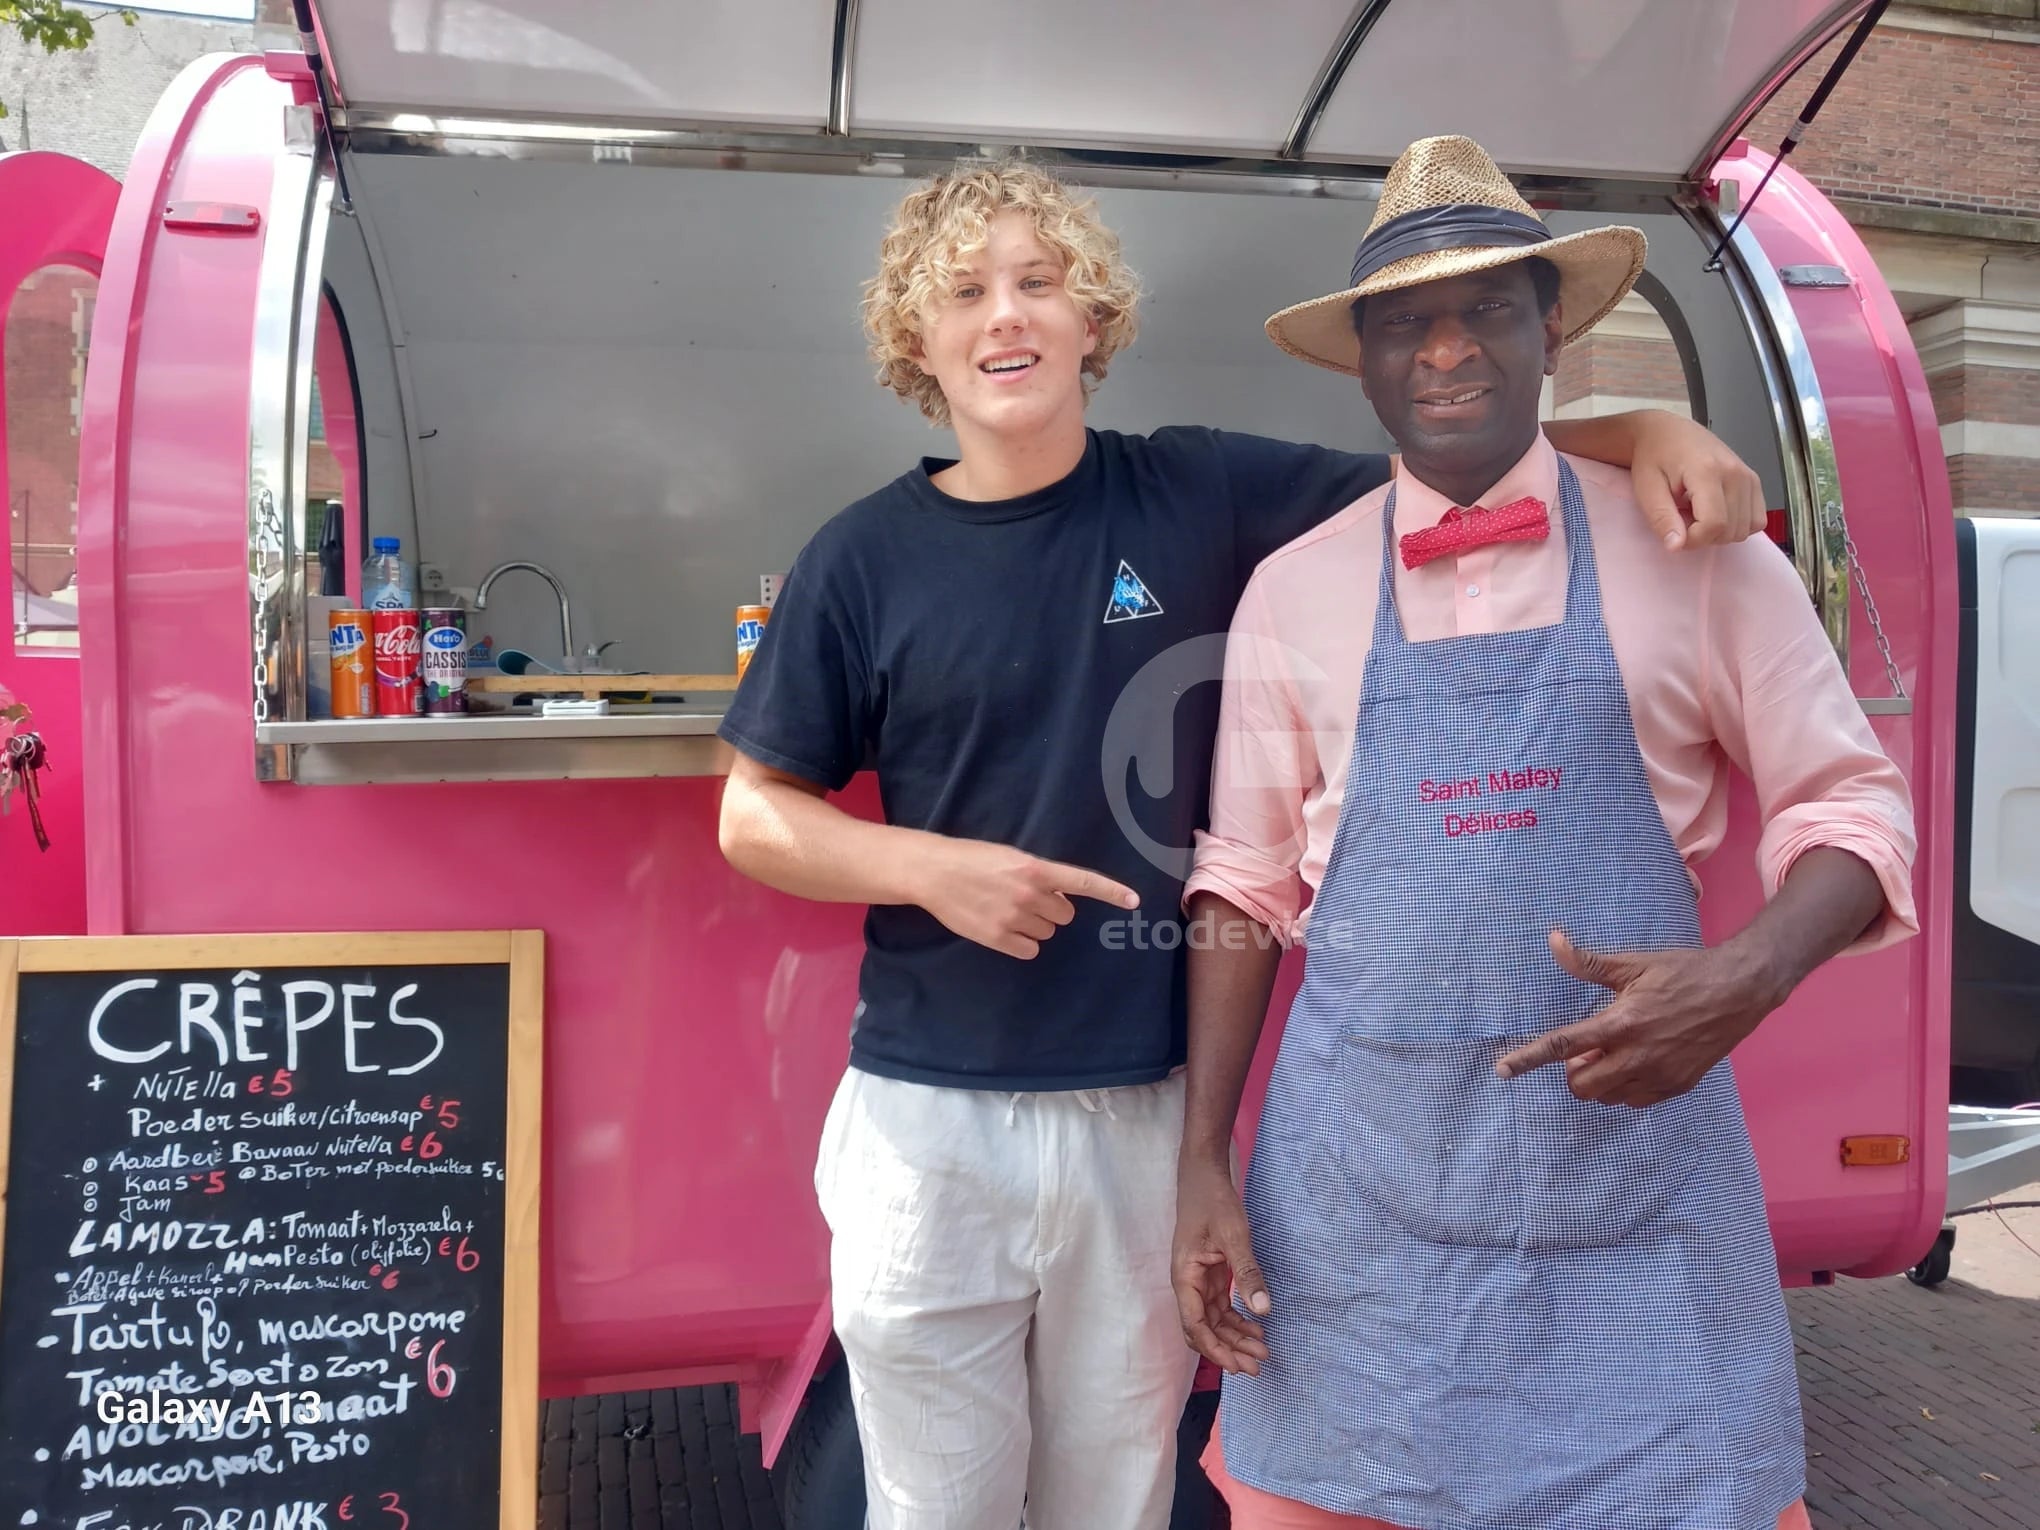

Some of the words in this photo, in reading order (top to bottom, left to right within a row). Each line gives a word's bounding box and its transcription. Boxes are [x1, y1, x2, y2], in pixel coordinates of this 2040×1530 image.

[329, 625, 365, 646] NTA
[425, 651, 467, 669] CASSIS
[1419, 777, 1481, 803] Saint
[88, 970, 444, 1076] CRÊPES
